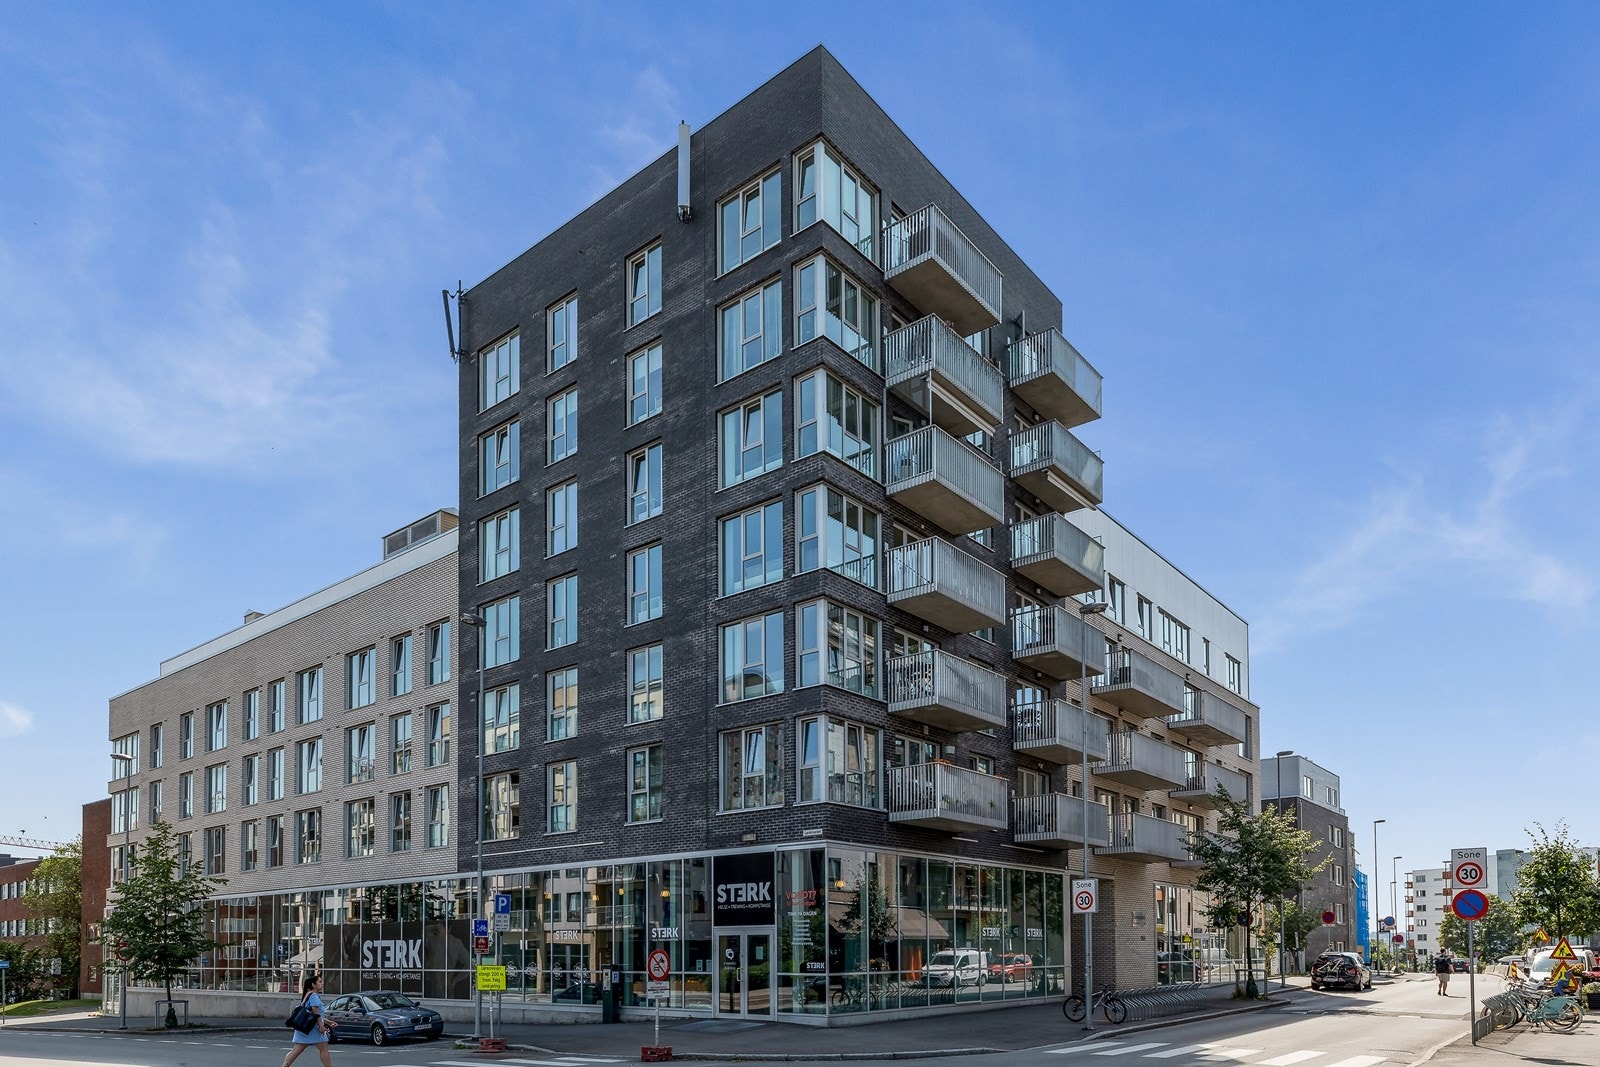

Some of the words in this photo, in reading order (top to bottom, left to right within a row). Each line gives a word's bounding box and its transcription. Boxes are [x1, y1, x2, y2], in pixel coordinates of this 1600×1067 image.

[1457, 851, 1481, 859] Sone
[1461, 868, 1478, 880] 30
[717, 882, 771, 903] STERK
[498, 897, 507, 911] P
[1079, 895, 1090, 906] 30
[363, 940, 422, 968] STERK
